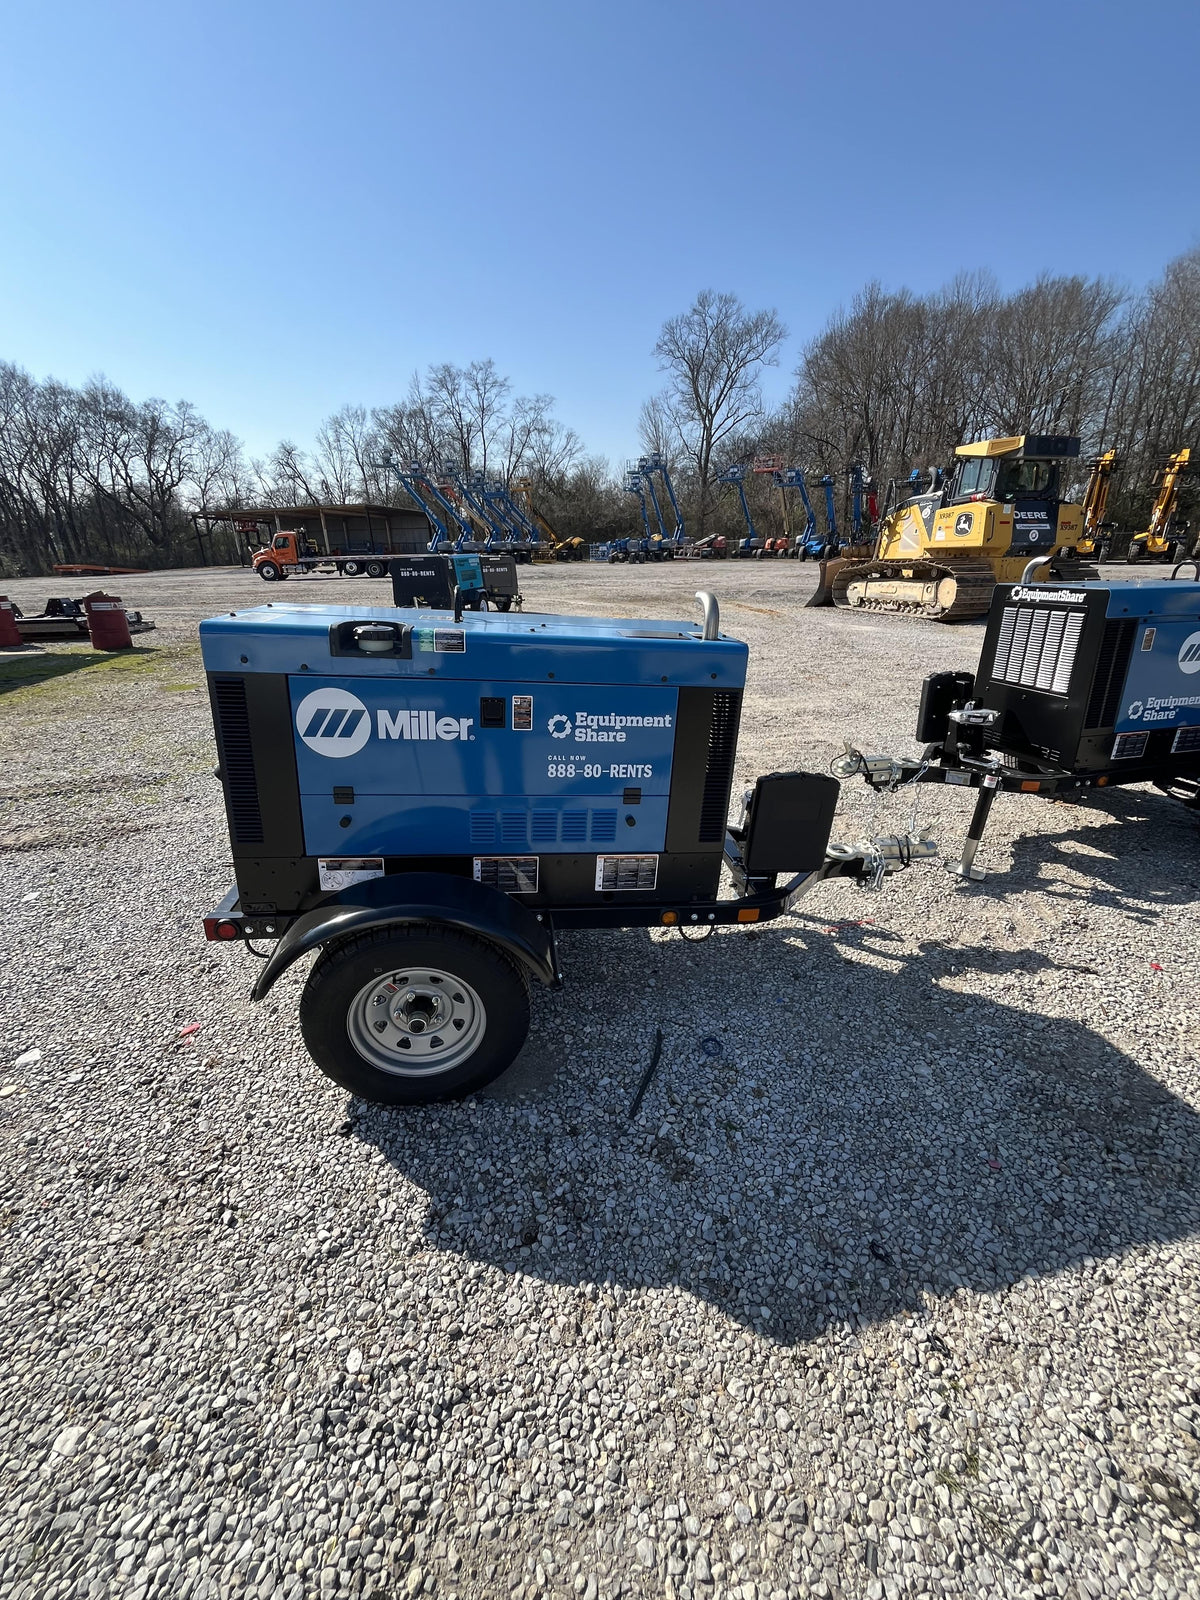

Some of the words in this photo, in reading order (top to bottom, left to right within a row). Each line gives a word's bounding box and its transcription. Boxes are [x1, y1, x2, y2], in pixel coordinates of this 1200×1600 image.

[1013, 510, 1048, 519] DEERE
[1146, 695, 1200, 710] Equipmen
[575, 711, 672, 730] Equipment
[1142, 709, 1176, 721] Share
[376, 709, 474, 741] Miller
[574, 728, 627, 743] Share
[547, 763, 653, 778] 888-80-RENTS
